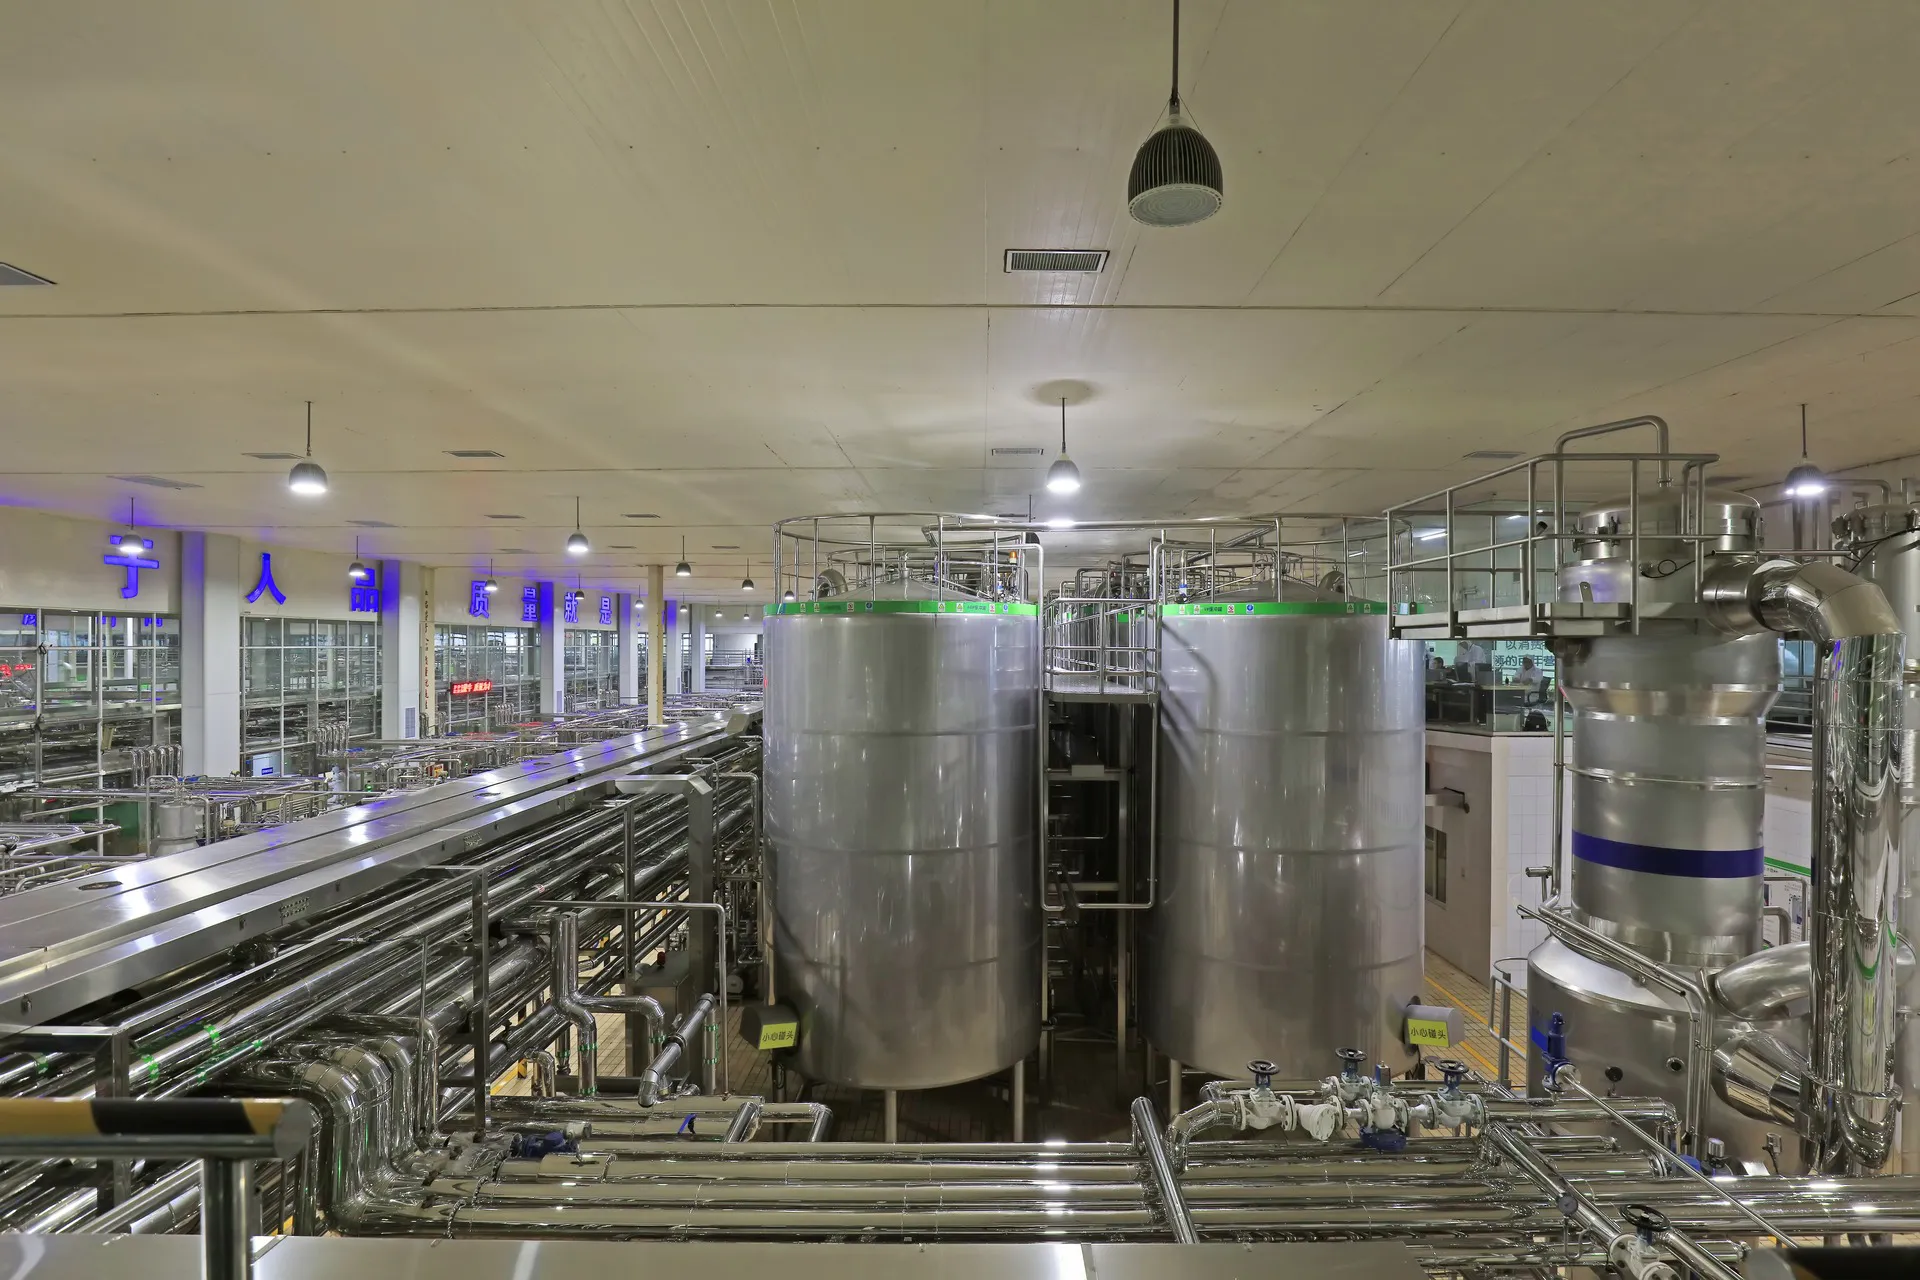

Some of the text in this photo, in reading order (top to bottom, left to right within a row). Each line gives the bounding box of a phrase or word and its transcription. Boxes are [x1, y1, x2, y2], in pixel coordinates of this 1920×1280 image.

[1505, 640, 1546, 651] 以消费
[762, 1030, 794, 1042] 小心碰头
[1410, 1027, 1447, 1040] 小心碰头
